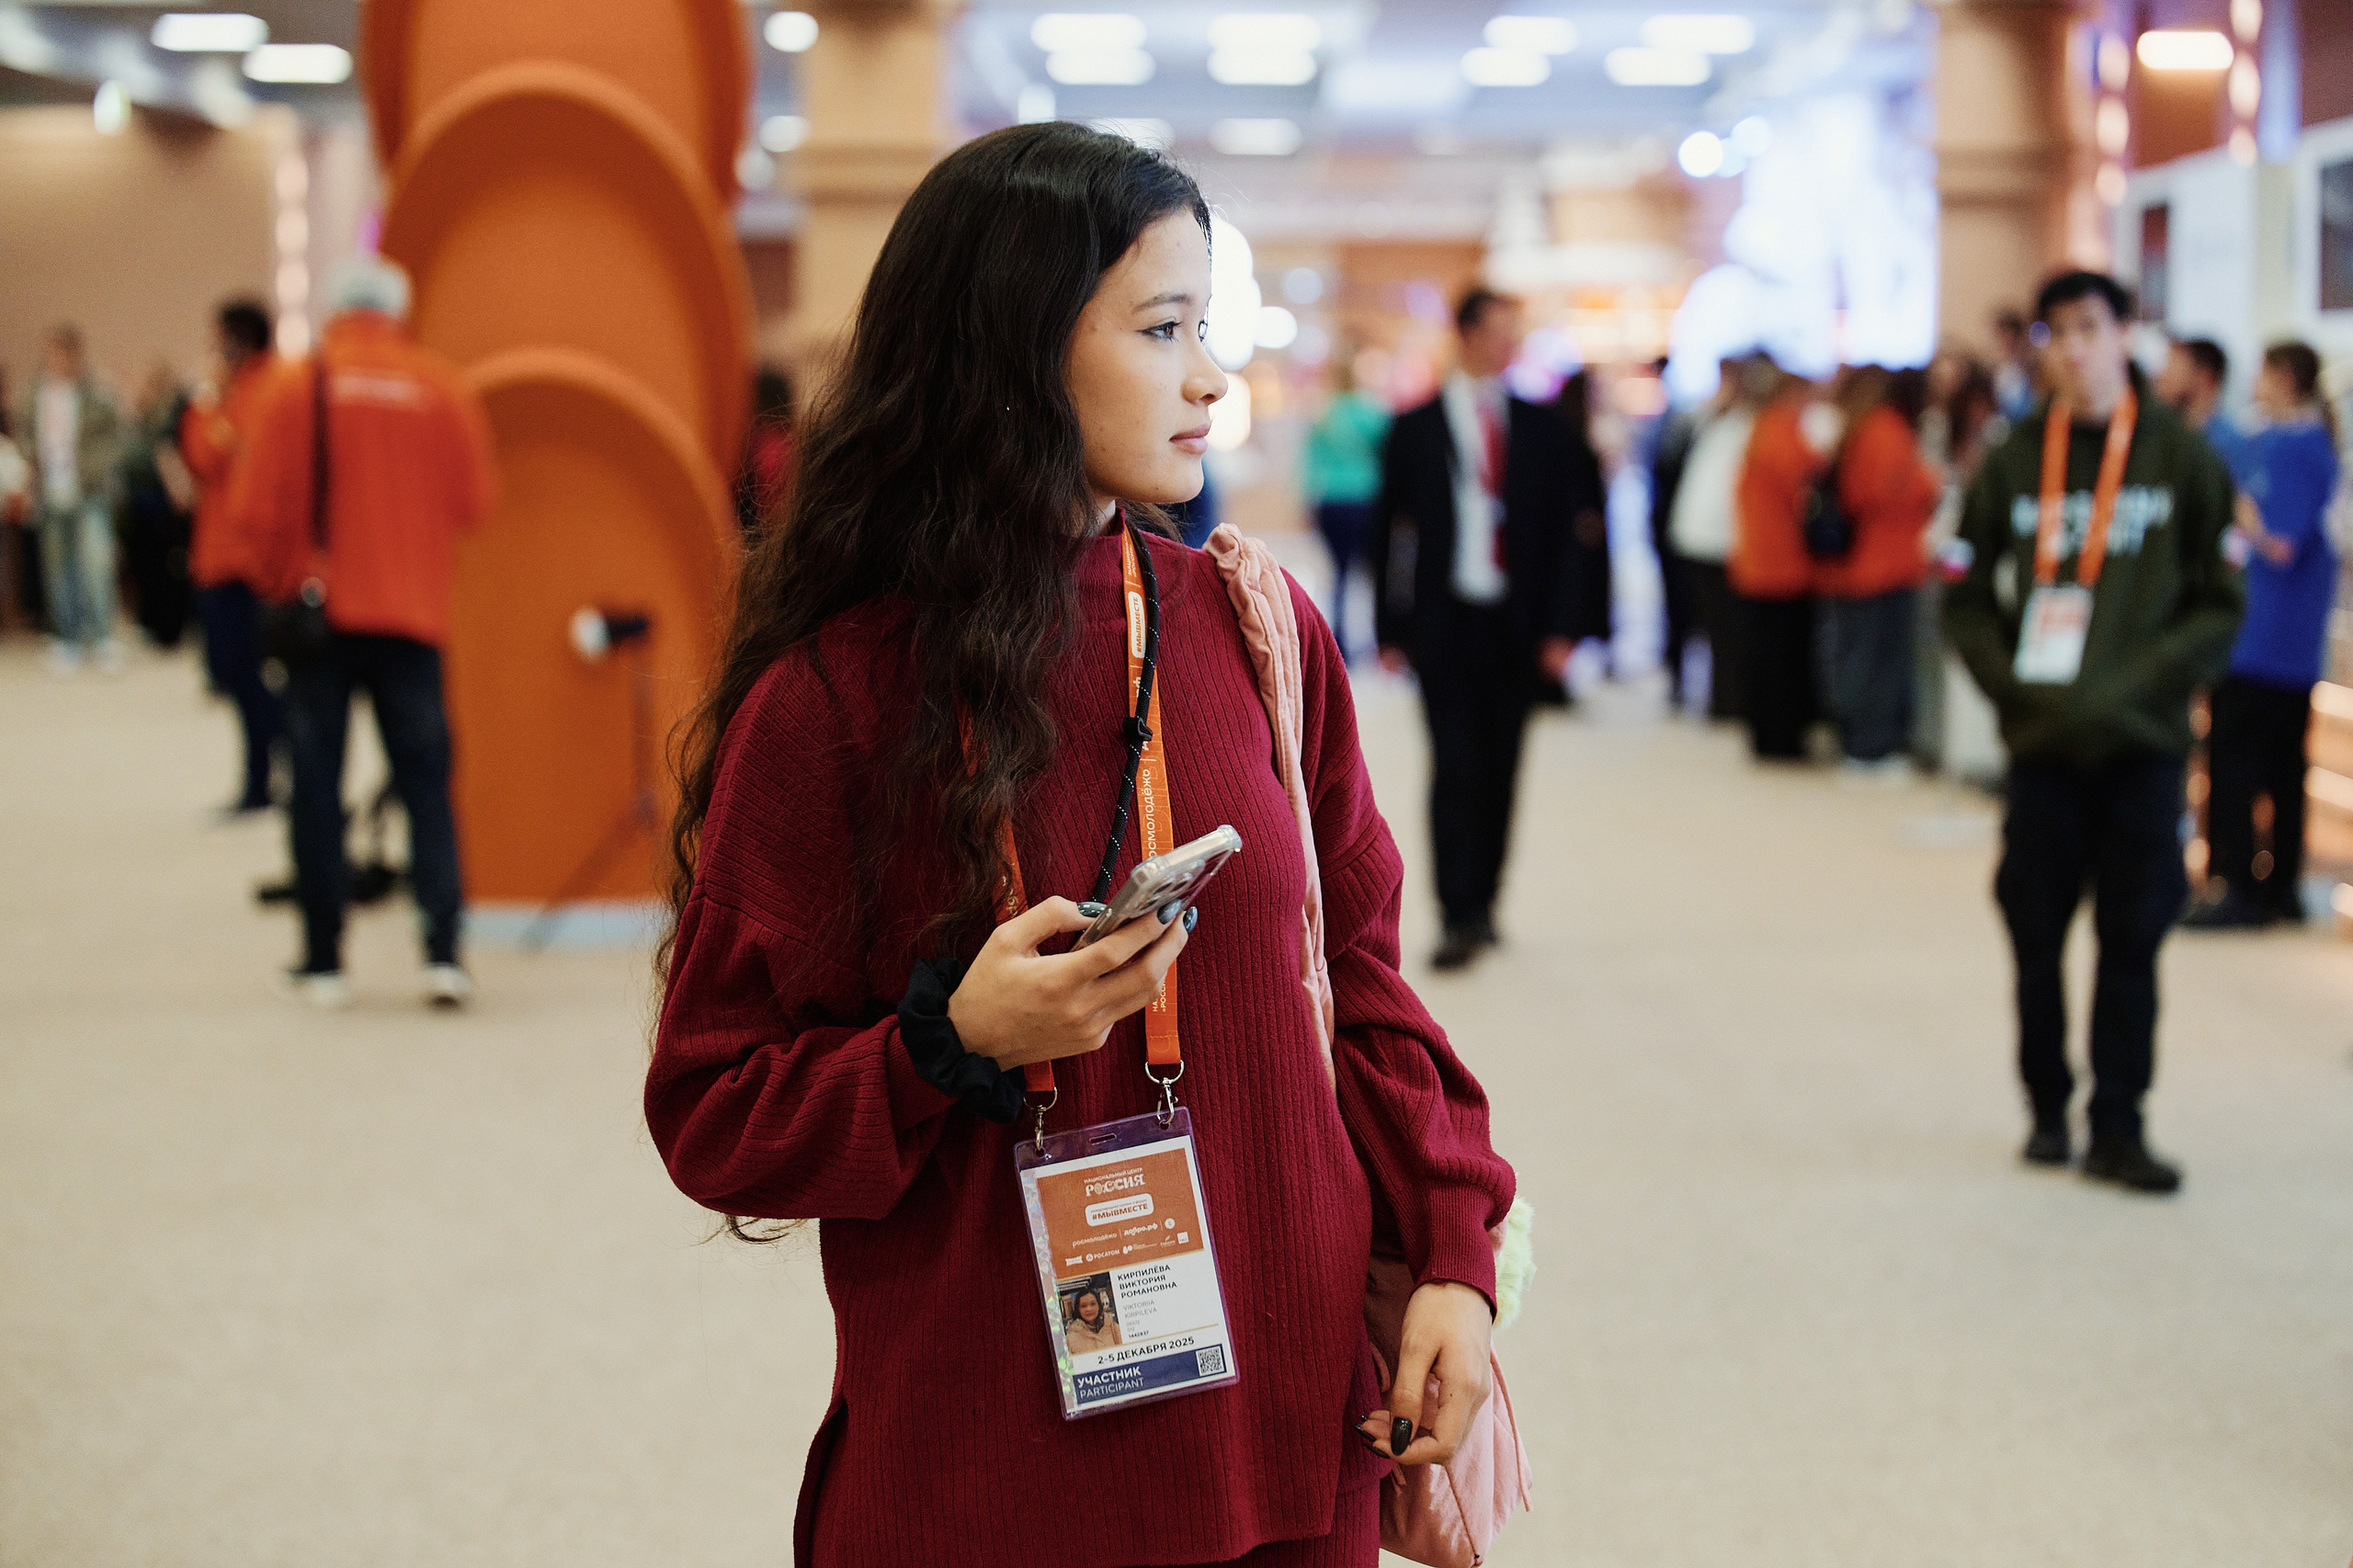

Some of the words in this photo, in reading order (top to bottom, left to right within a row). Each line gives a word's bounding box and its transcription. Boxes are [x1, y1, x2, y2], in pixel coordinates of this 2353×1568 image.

[1132, 597, 1142, 653] #МЫВМЕСТЕ
[1142, 768, 1156, 858] осмолодёжь
[1084, 1170, 1127, 1184] НАЦИОНАЛЬНЫЙ
[1127, 1167, 1143, 1176] ЦЕНТР
[1086, 1173, 1146, 1197] РОССИЯ
[1092, 1203, 1149, 1221] #МЫВМЕСТЕ
[1123, 1222, 1158, 1236] добро.рф
[1094, 1248, 1120, 1259] РОСАТОМ
[1117, 1264, 1171, 1281] КИРПИЛЁВА
[1119, 1274, 1166, 1290] ВИКТОРИЯ
[1120, 1281, 1177, 1299] РОМАНОВНА
[1097, 1353, 1115, 1365] 2-5
[1117, 1342, 1167, 1362] ДЕКАБРЯ
[1169, 1335, 1195, 1349] 2025
[1076, 1366, 1142, 1388] УЧАСТНИК
[1079, 1378, 1145, 1400] PARTICIPANT
